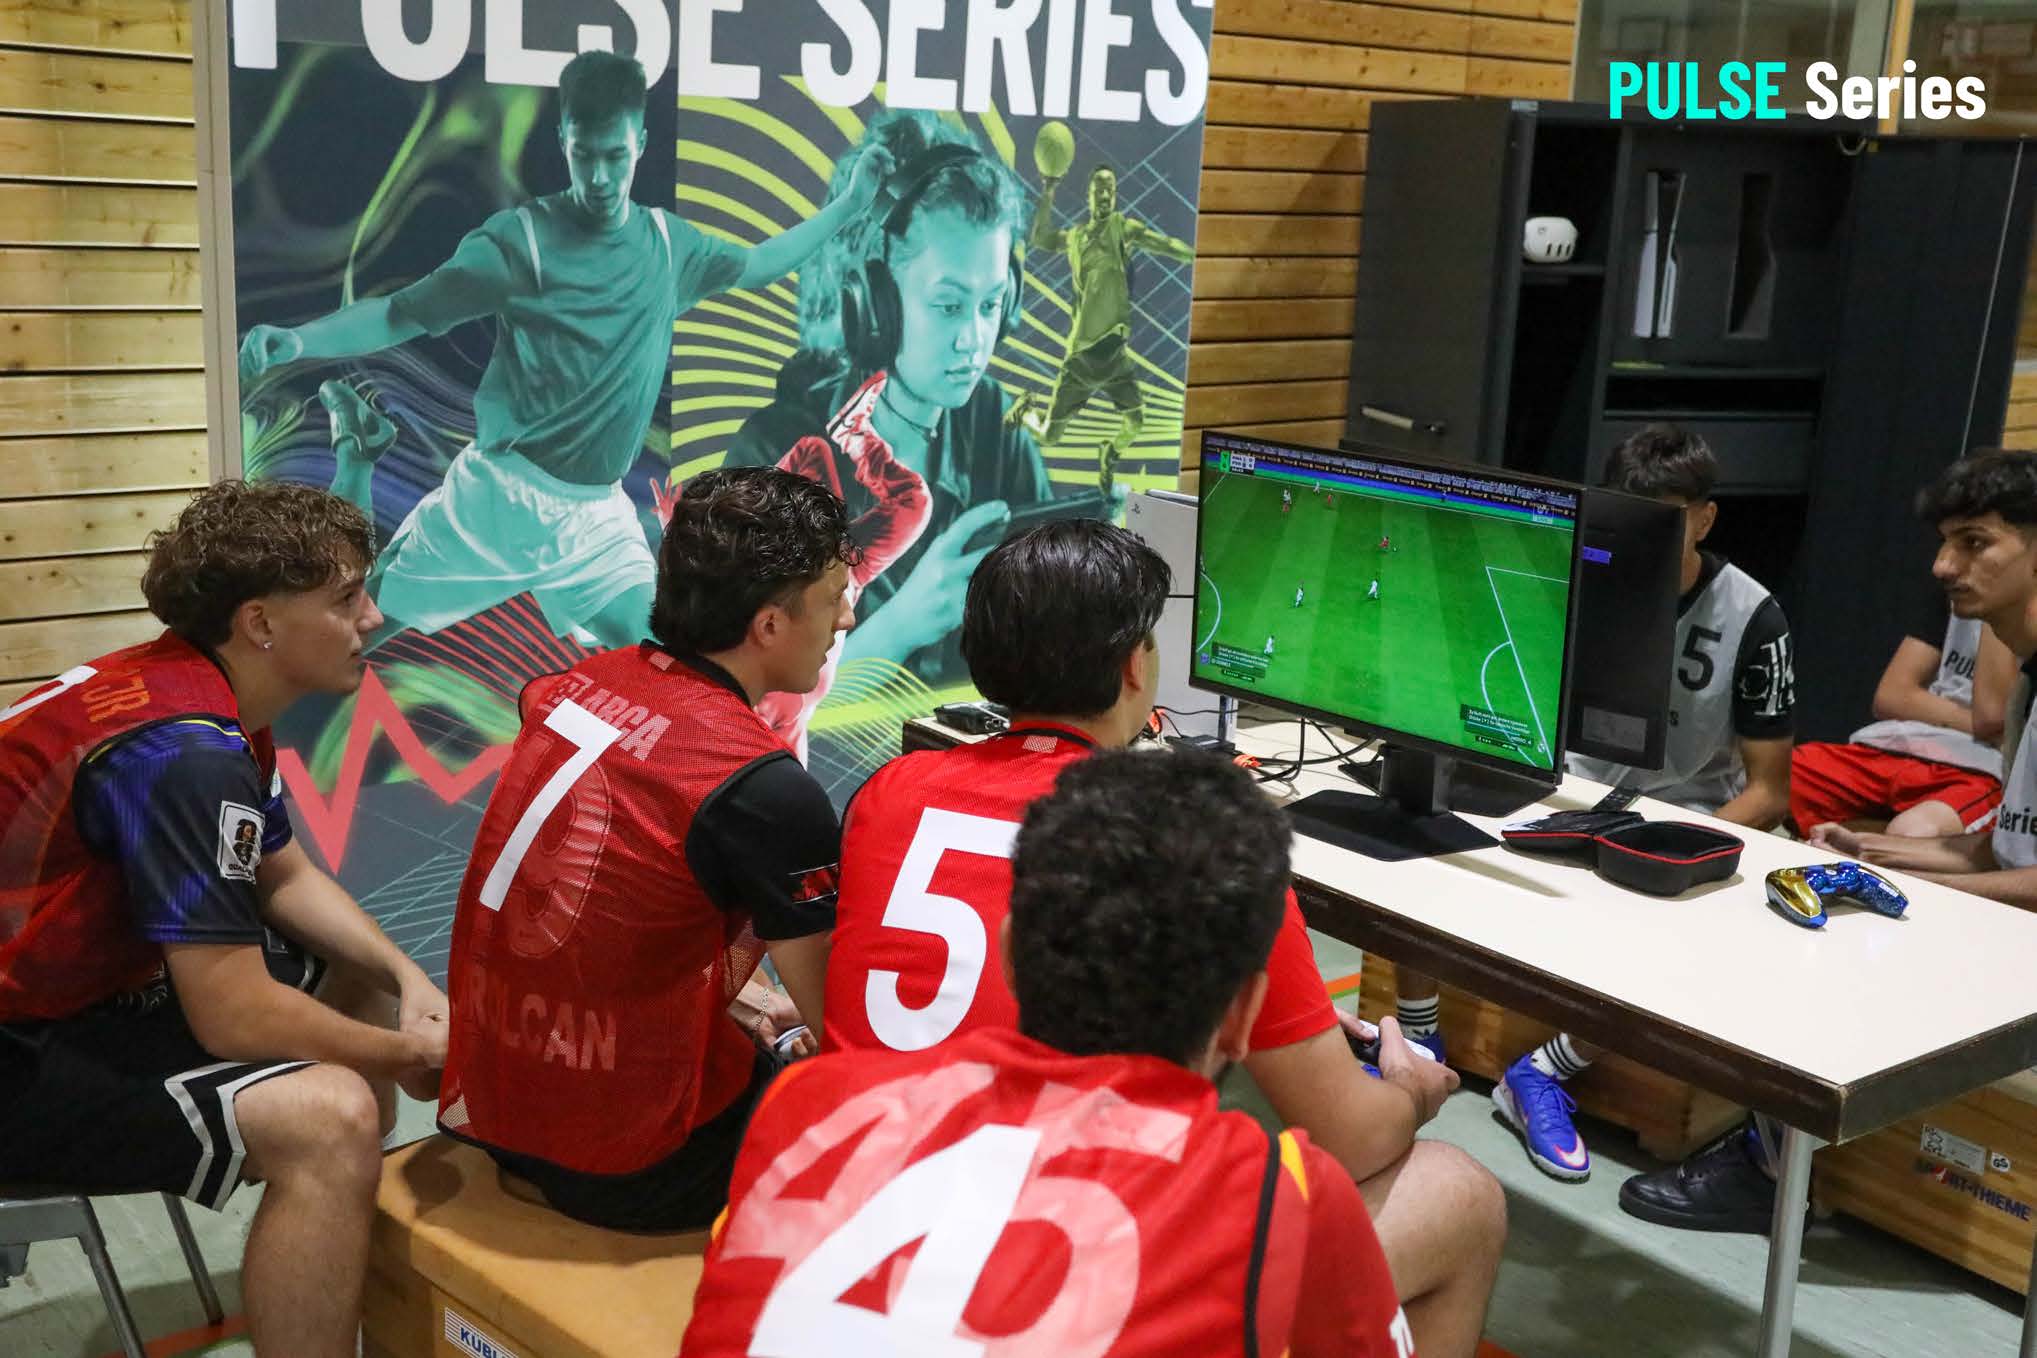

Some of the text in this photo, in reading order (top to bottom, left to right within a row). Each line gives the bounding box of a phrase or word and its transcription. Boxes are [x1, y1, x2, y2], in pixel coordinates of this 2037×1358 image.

[233, 0, 1214, 126] ULSE SERIES
[1678, 624, 1722, 691] 5
[479, 698, 622, 913] 7
[865, 806, 1022, 1052] 5
[748, 1124, 1040, 1358] 4
